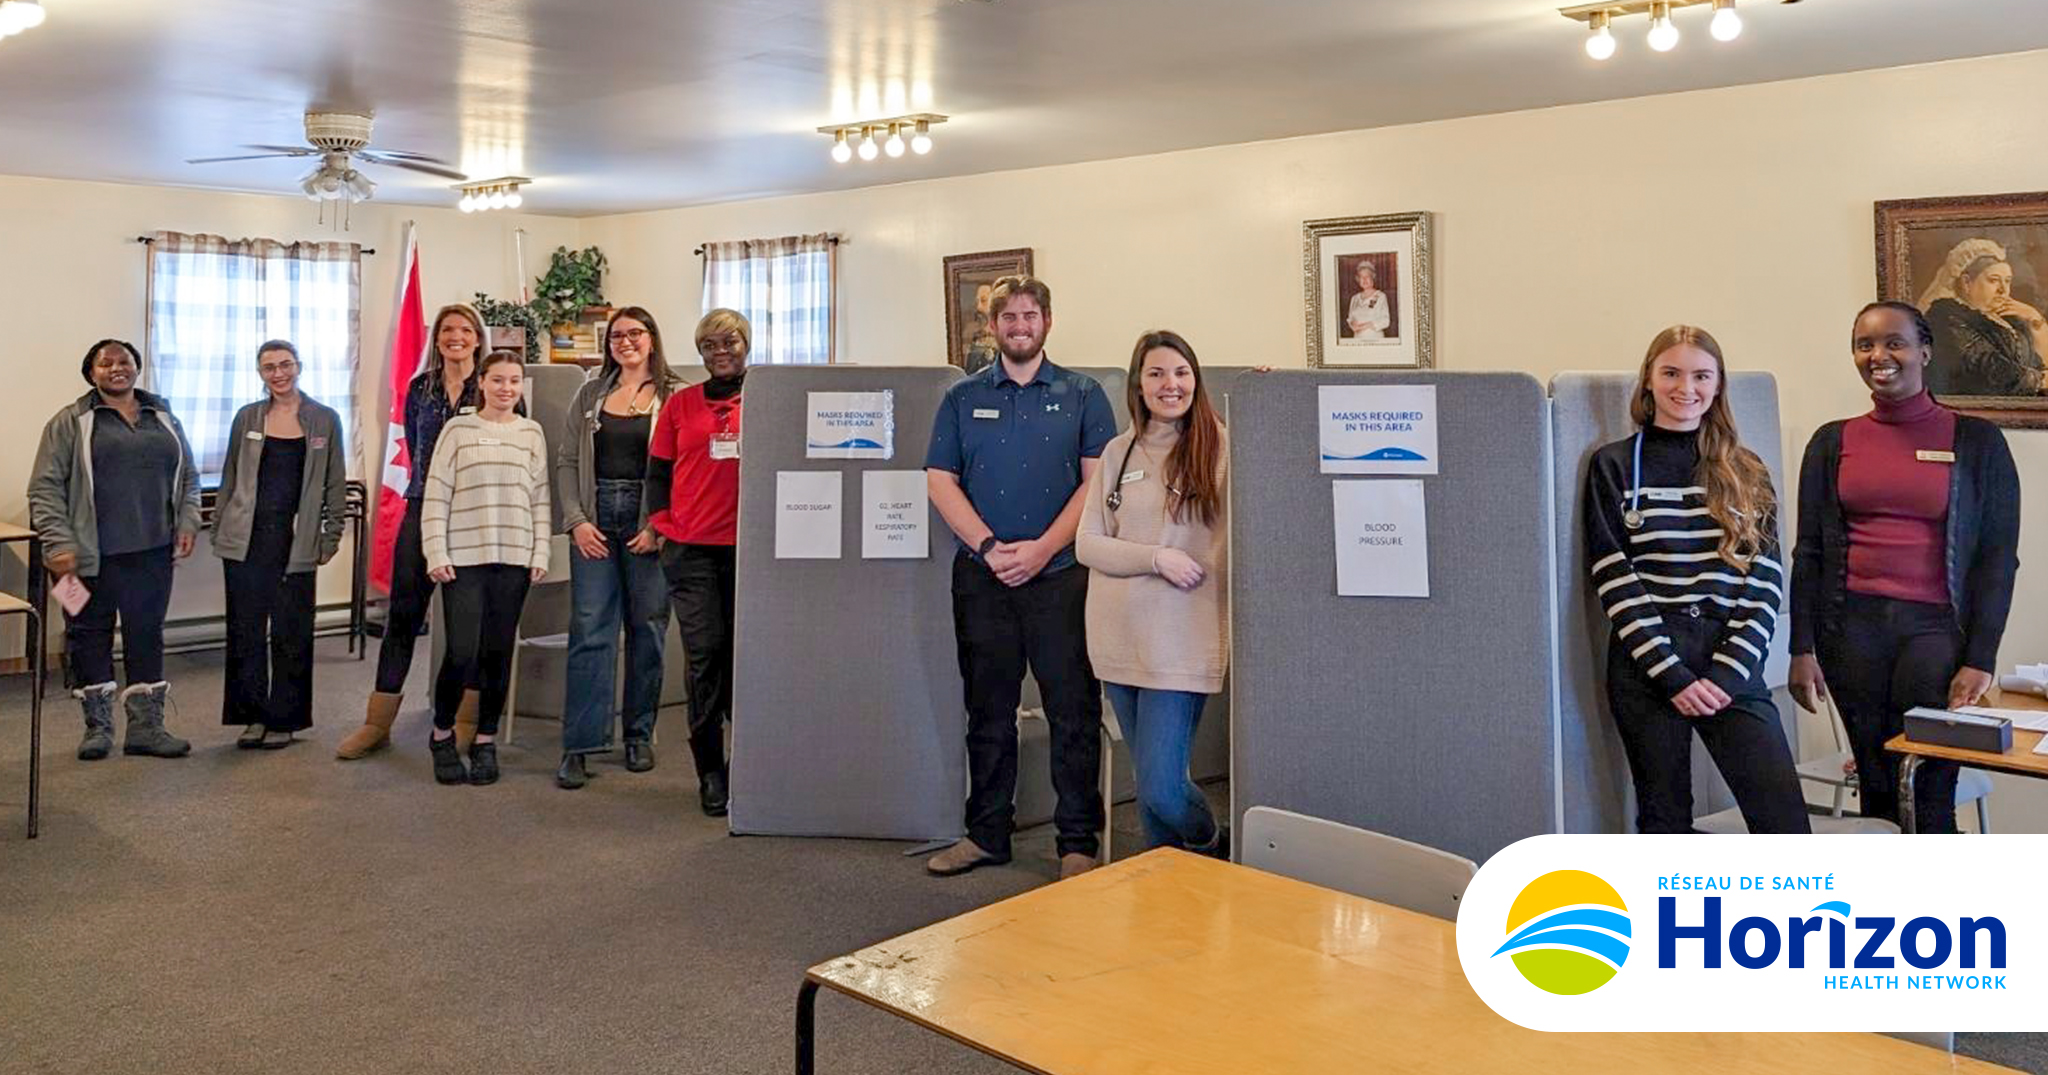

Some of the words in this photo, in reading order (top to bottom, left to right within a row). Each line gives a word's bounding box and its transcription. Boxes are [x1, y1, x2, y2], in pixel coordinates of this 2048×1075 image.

[817, 411, 843, 419] MASKS
[844, 411, 883, 420] REQUIRED
[1331, 411, 1367, 421] MASKS
[1369, 411, 1423, 422] REQUIRED
[825, 419, 835, 427] IN
[837, 419, 853, 427] THIS
[854, 419, 875, 428] AREA
[1345, 422, 1357, 432] IN
[1359, 422, 1382, 432] THIS
[1384, 422, 1413, 432] AREA
[785, 503, 808, 511] BLOOD
[809, 503, 832, 511] SUGAR
[890, 502, 913, 510] HEART
[874, 523, 917, 531] RESPIRATORY
[1364, 523, 1397, 532] BLOOD
[1358, 536, 1404, 546] PRESSURE
